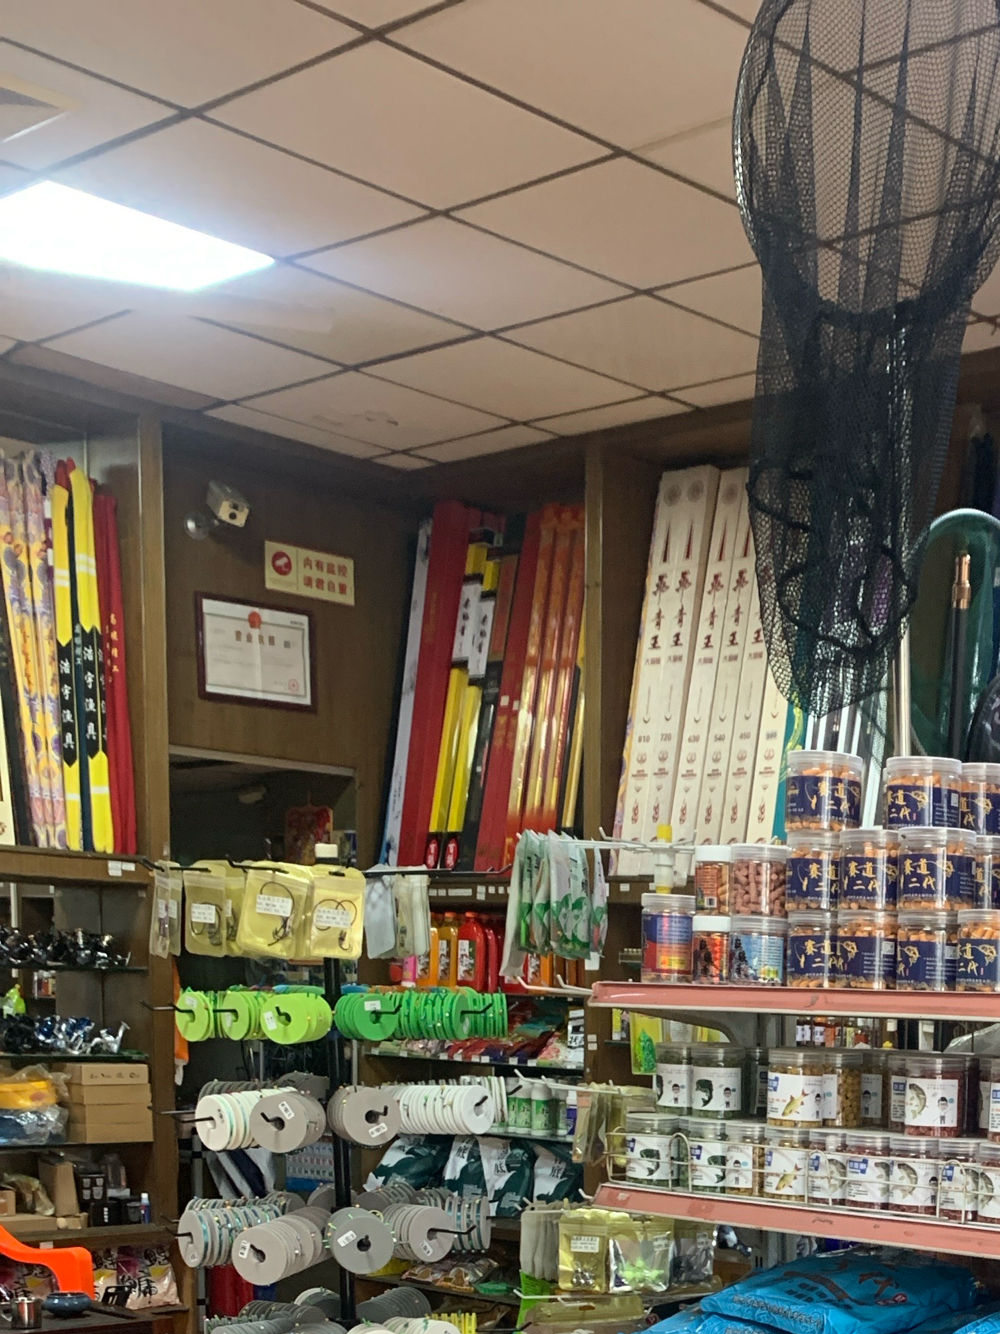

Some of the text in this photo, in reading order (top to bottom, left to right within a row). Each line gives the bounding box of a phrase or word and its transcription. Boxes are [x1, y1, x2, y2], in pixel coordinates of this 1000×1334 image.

[638, 734, 651, 743] 810
[660, 732, 672, 742] 720
[687, 734, 700, 743] 630
[713, 733, 726, 742] 540
[739, 731, 751, 740] 450
